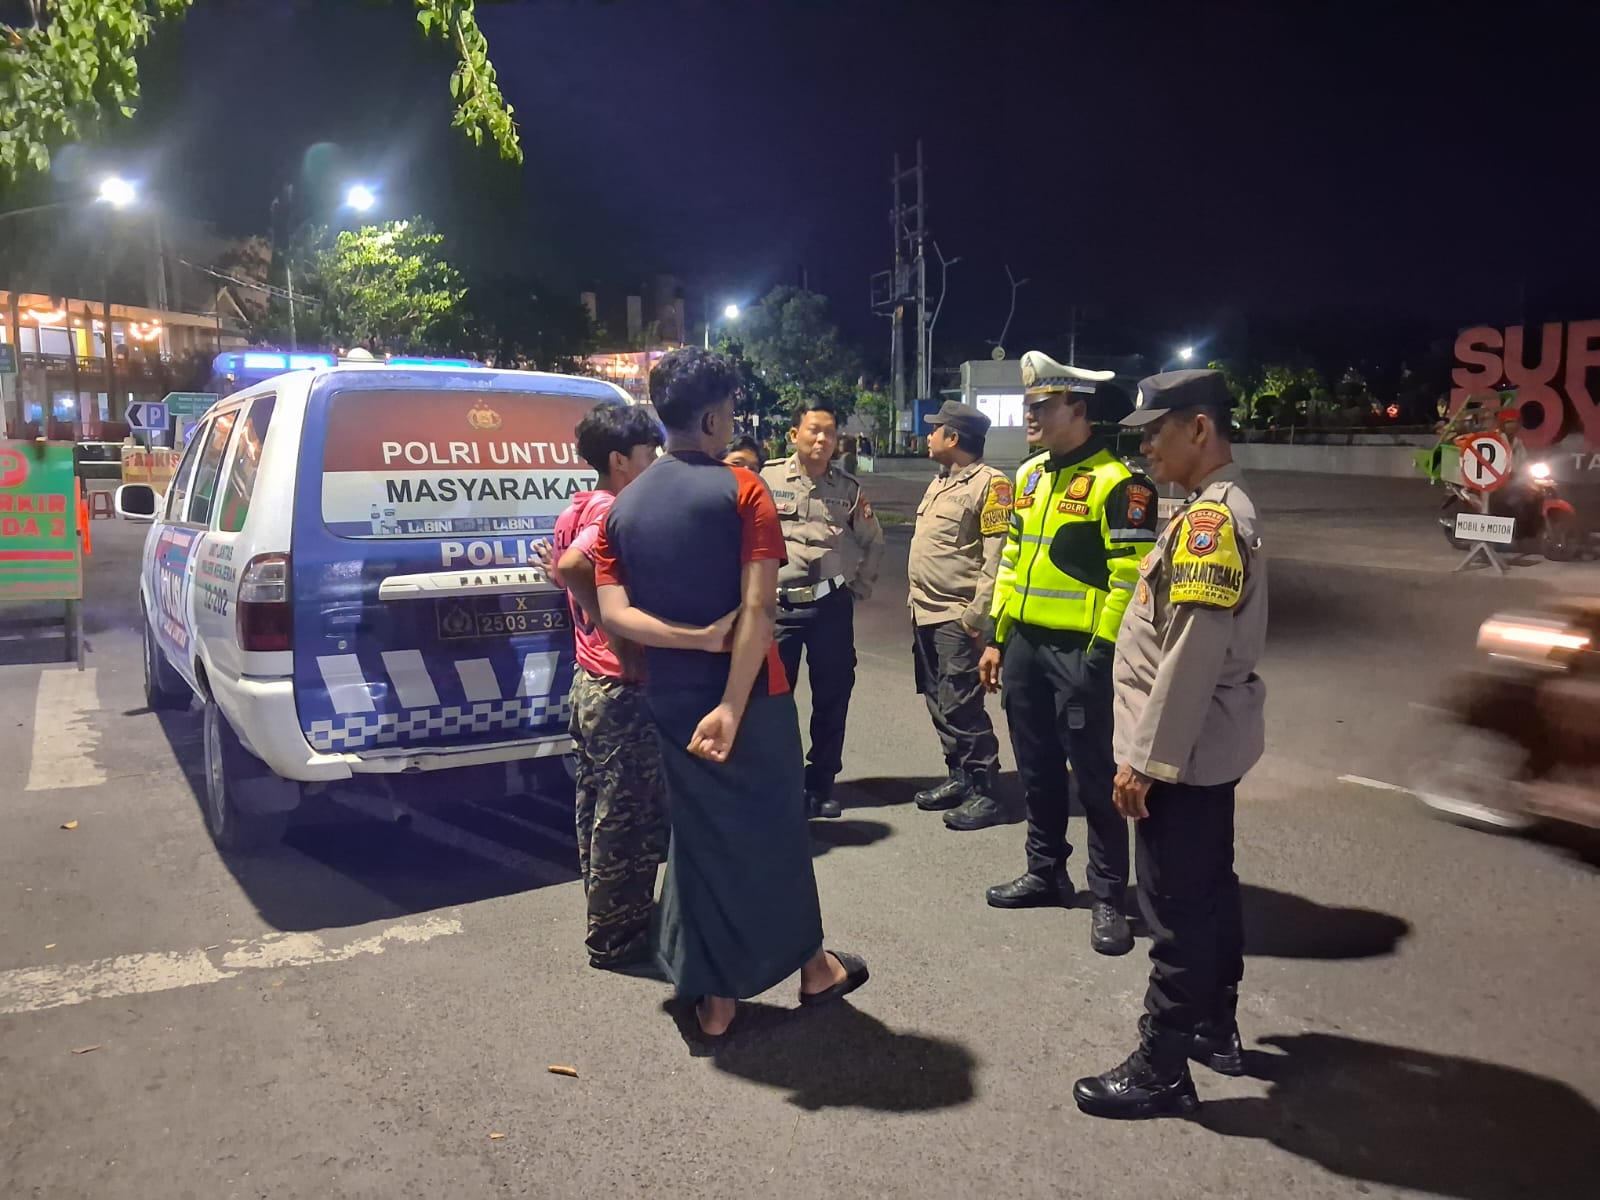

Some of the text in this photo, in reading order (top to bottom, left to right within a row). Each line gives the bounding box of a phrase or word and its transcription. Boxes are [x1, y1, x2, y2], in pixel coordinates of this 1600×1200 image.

[151, 407, 160, 424] P
[382, 441, 481, 465] POLRI
[1477, 443, 1496, 479] P
[386, 477, 597, 503] MASYARAKAT
[1060, 503, 1086, 512] POLRI
[49, 518, 66, 536] 2
[1457, 520, 1478, 532] MOBIL
[1487, 523, 1512, 535] MOTOR
[516, 597, 528, 610] X
